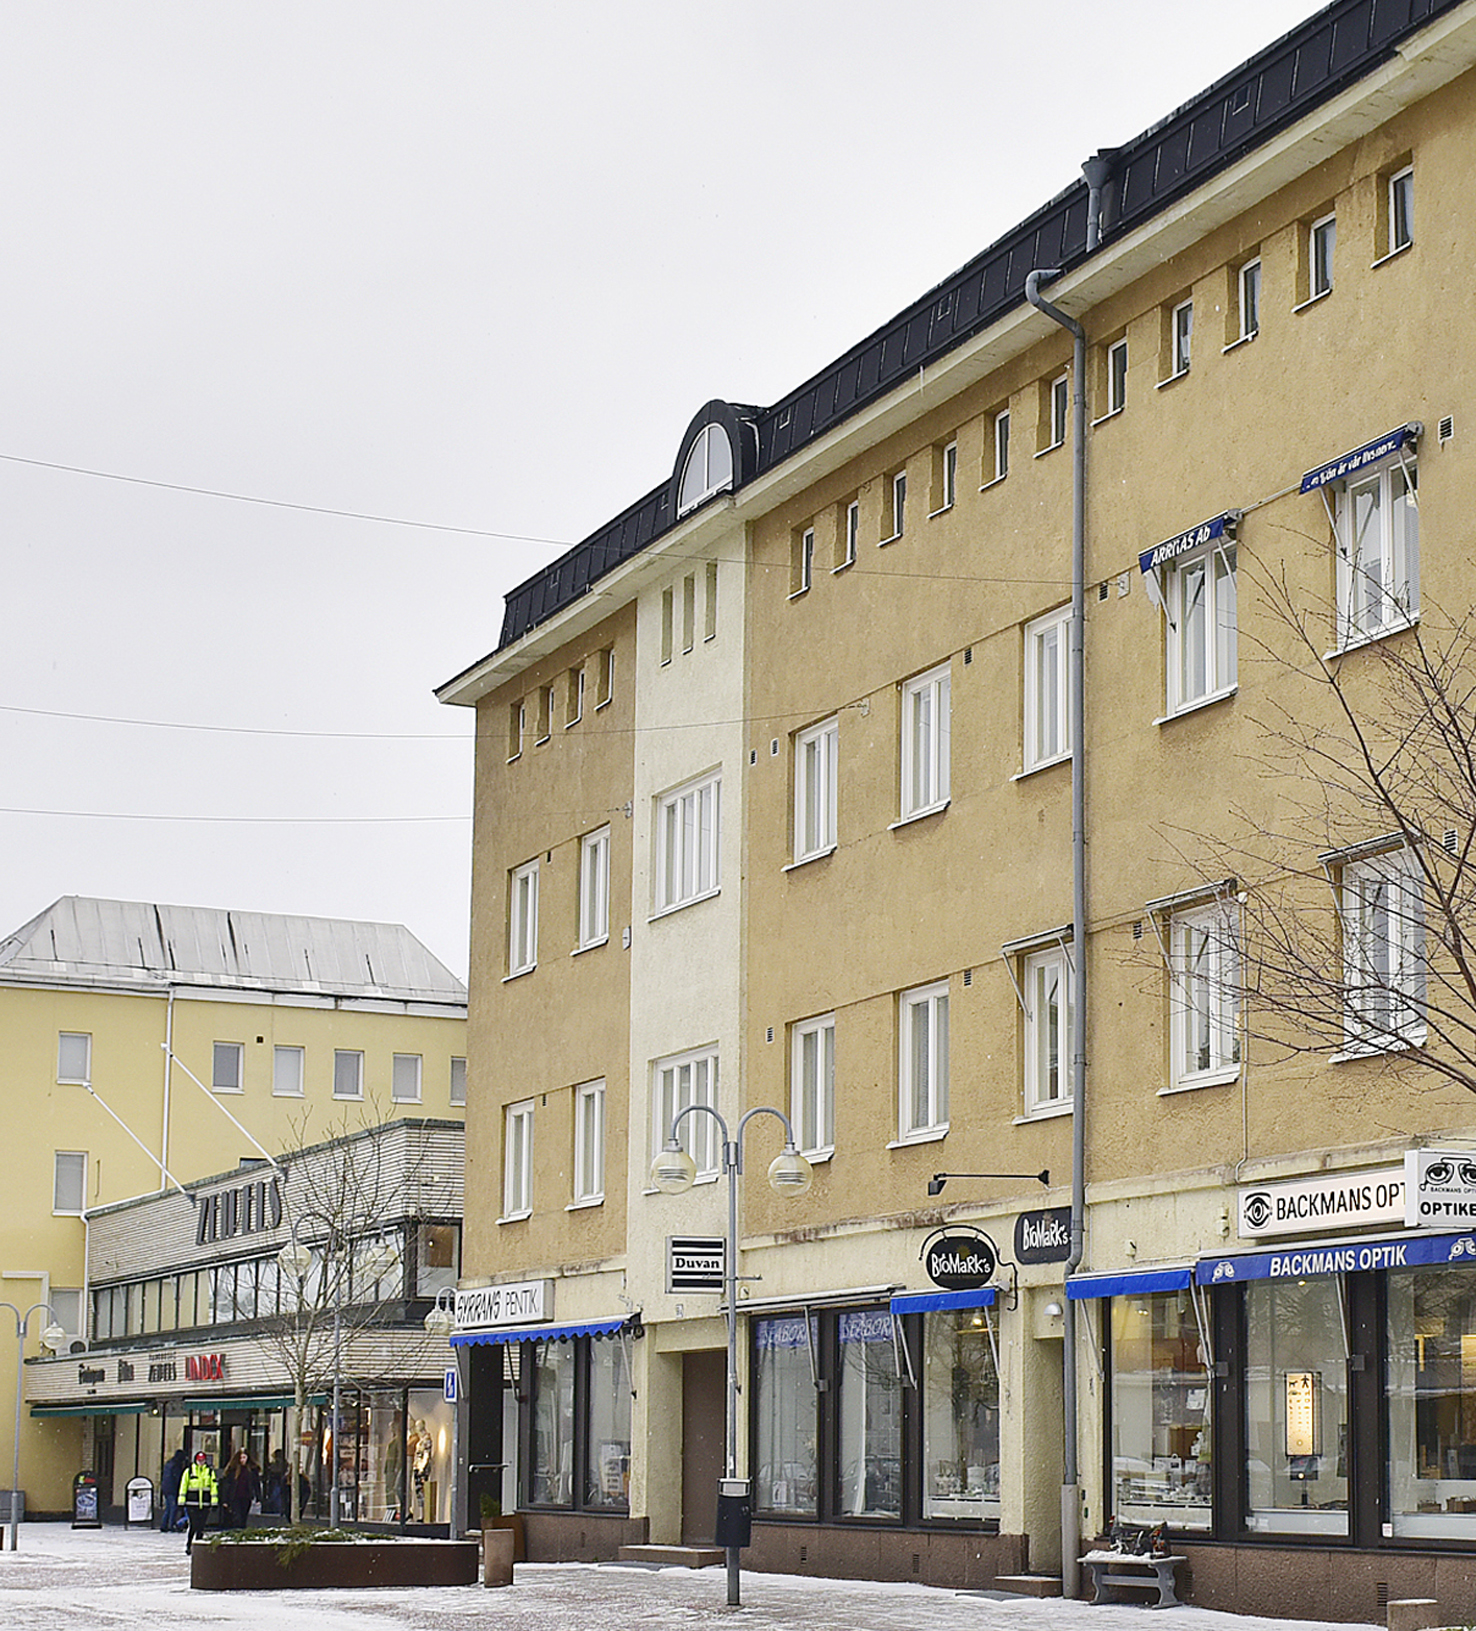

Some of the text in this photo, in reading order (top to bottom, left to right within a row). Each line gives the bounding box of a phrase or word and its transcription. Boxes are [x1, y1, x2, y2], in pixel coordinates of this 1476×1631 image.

[1150, 532, 1195, 567] ARRITAS
[1277, 1186, 1372, 1221] BACKMANS
[675, 1257, 720, 1269] Duvan
[1270, 1245, 1407, 1277] BACKMANS OPTIK
[457, 1288, 538, 1324] SYRRANS PENTIK
